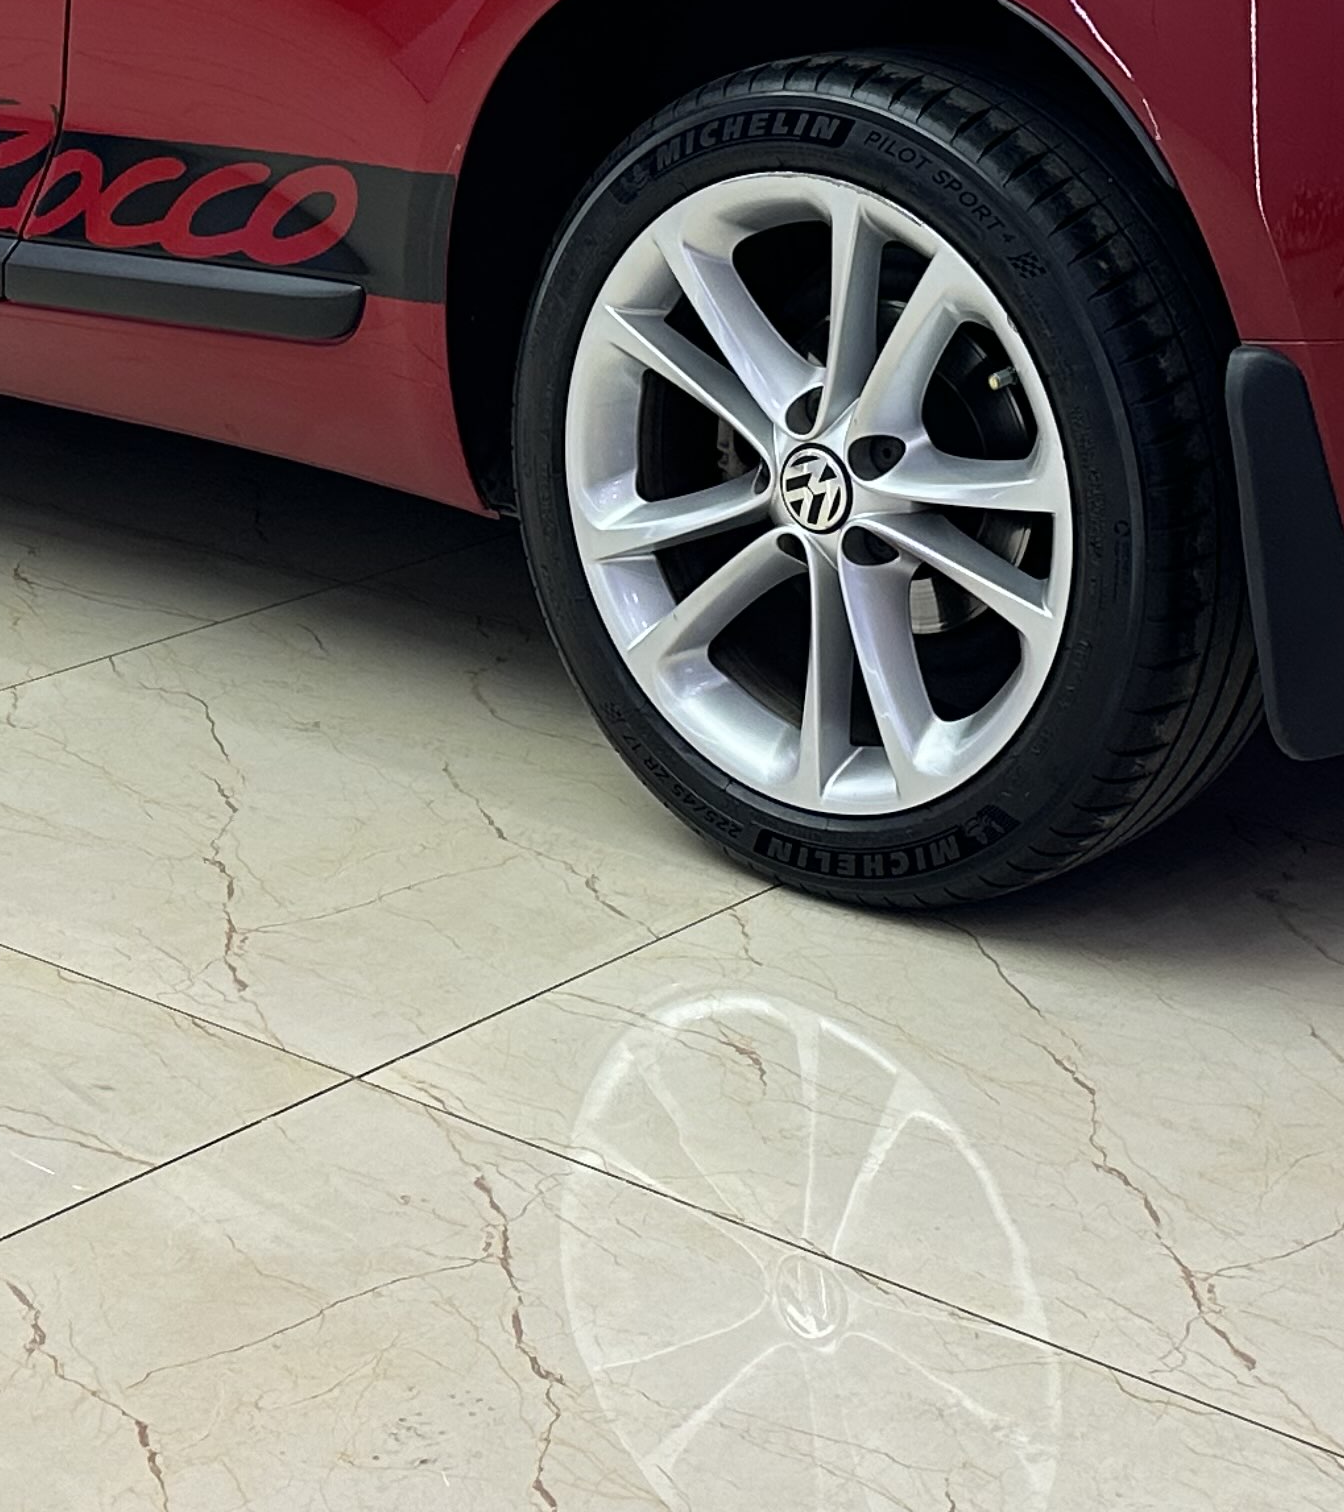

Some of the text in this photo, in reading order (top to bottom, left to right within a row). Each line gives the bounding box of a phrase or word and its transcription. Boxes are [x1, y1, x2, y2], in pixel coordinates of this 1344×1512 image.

[655, 112, 842, 170] MICHELIN
[863, 130, 933, 170] PILOT
[931, 169, 1006, 231] SPORT
[767, 835, 961, 877] MICHELIN
